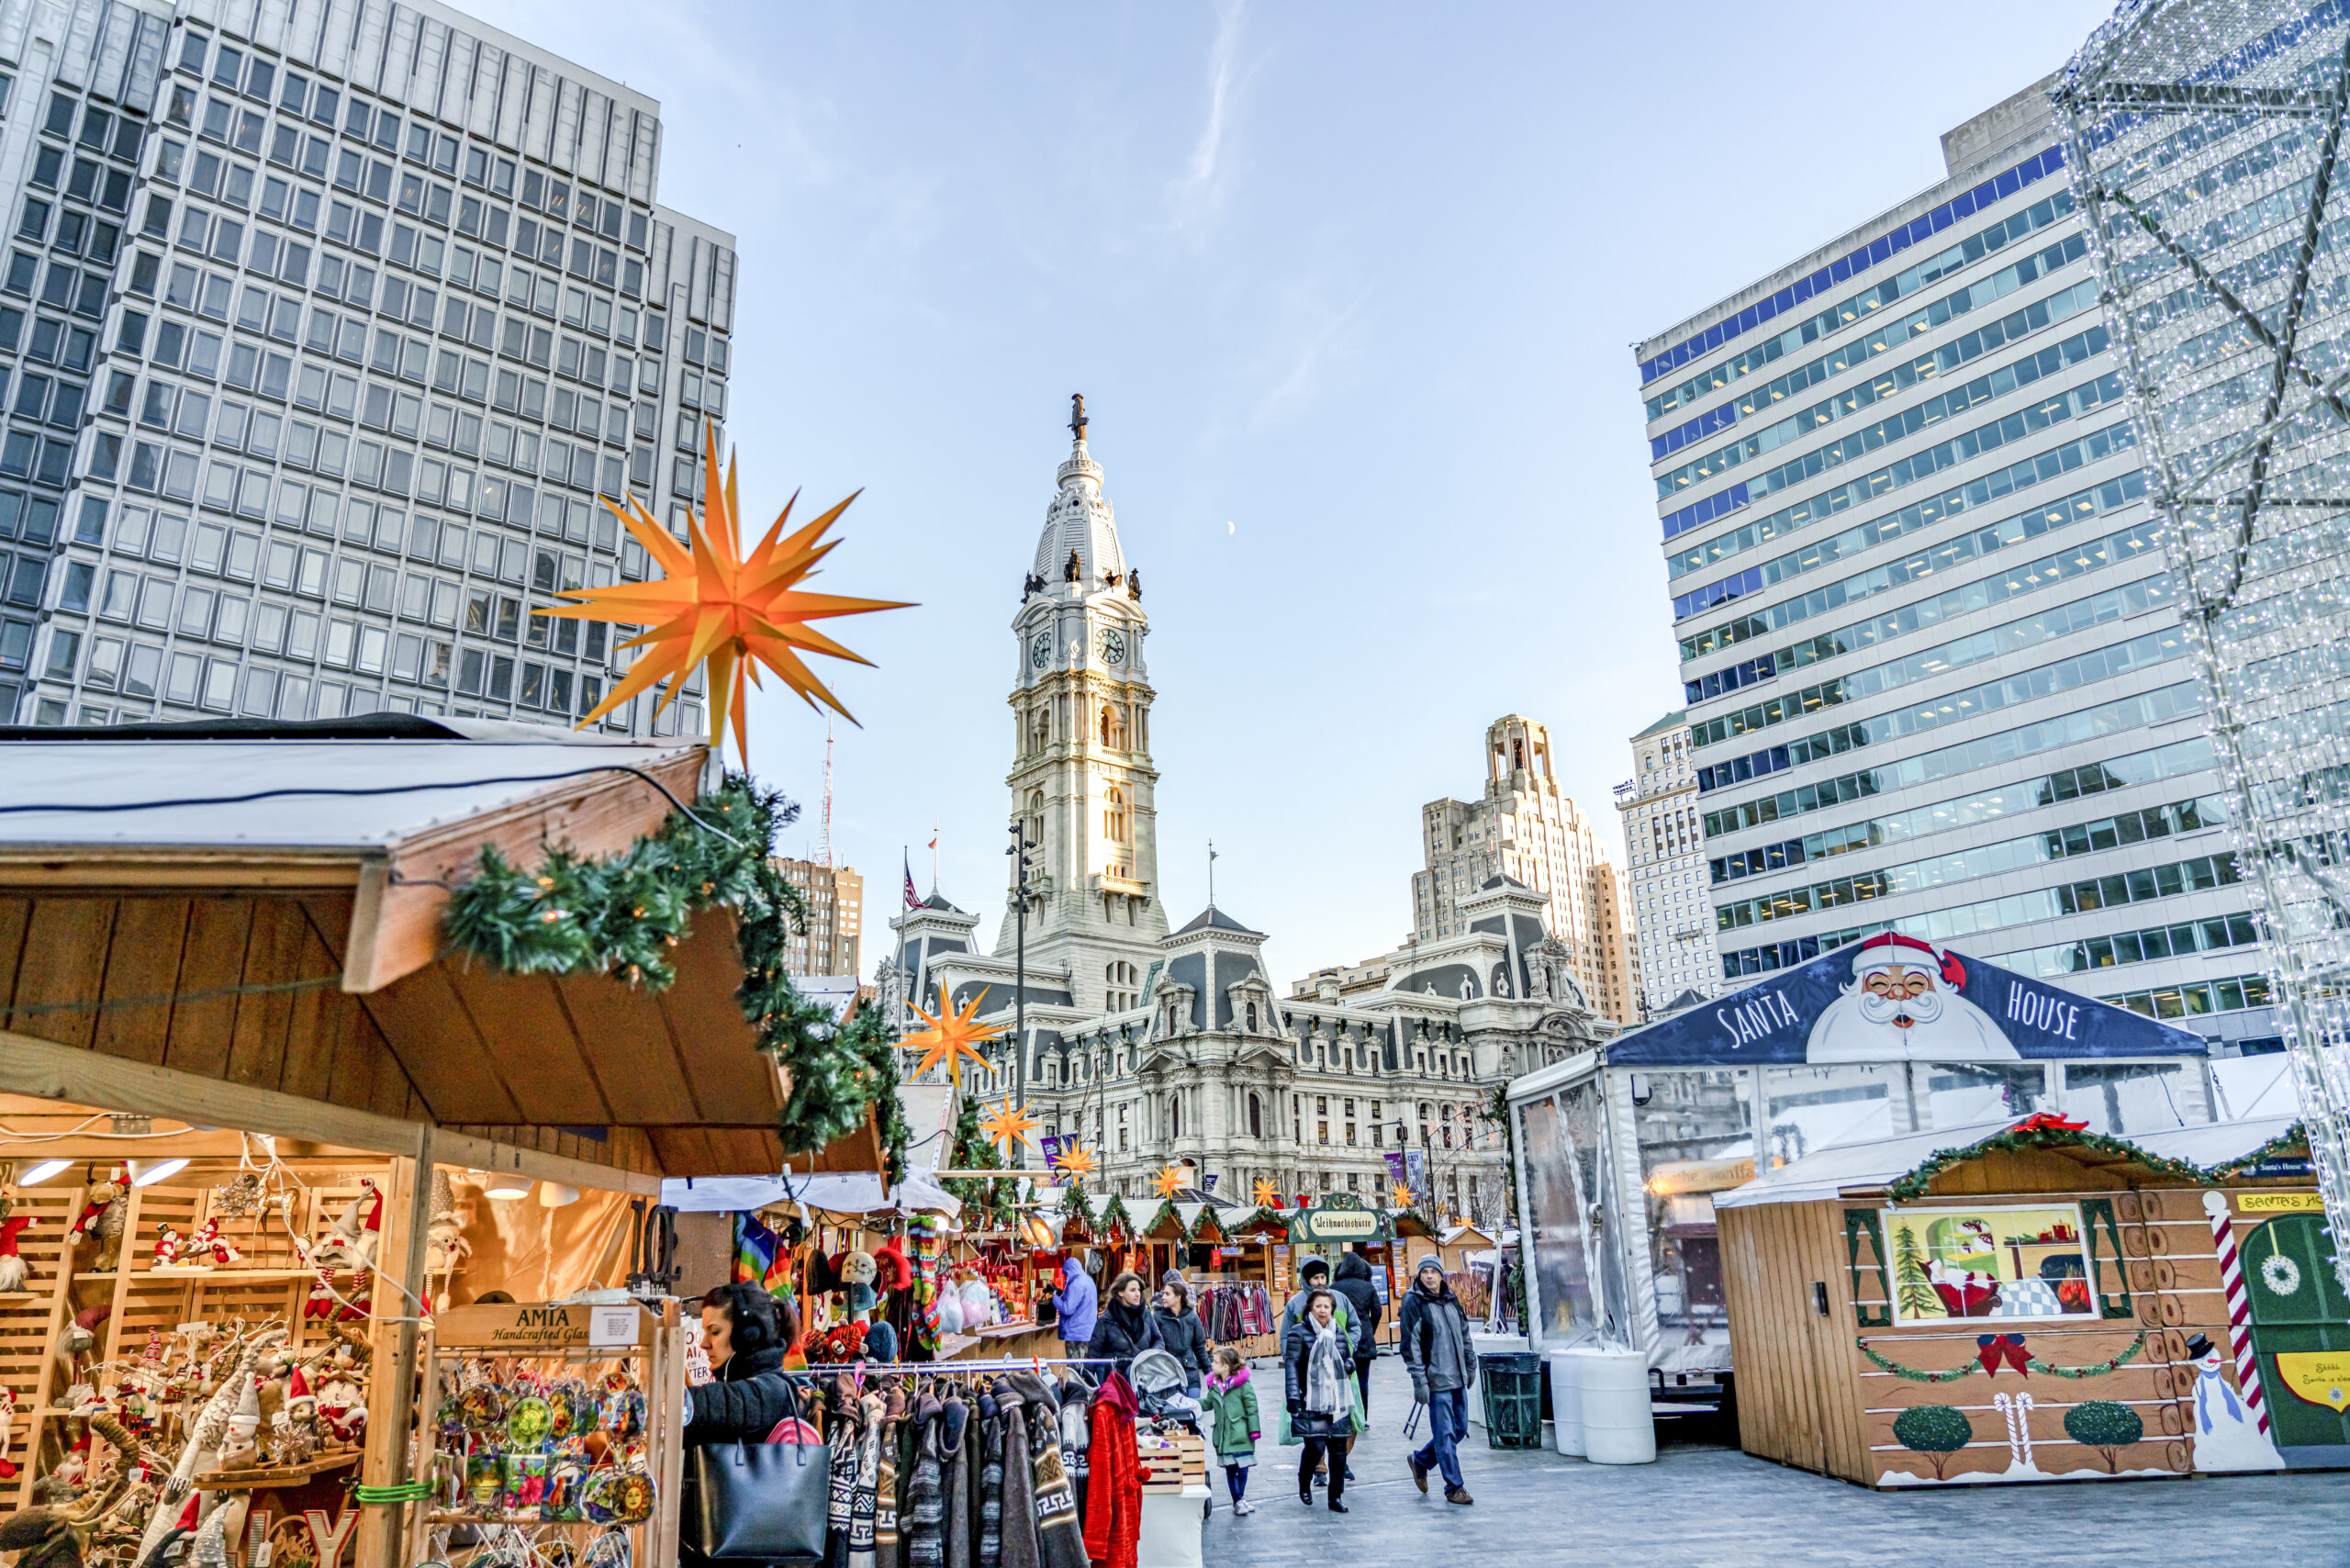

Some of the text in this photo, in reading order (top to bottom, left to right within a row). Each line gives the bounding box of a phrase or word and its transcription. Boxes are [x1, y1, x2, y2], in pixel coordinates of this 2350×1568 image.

[2008, 980, 2080, 1040] HOUSE
[1718, 990, 1798, 1048] SANTA
[2260, 1163, 2281, 1171] Santa's
[2283, 1162, 2302, 1170] House
[2244, 1196, 2300, 1208] SANTA'S
[1314, 1214, 1371, 1229] Weihnachtshütte
[516, 1309, 570, 1327] AMIA
[492, 1327, 560, 1345] Handcrafted
[2315, 1362, 2341, 1373] Shhhh
[2302, 1374, 2326, 1384] Santa
